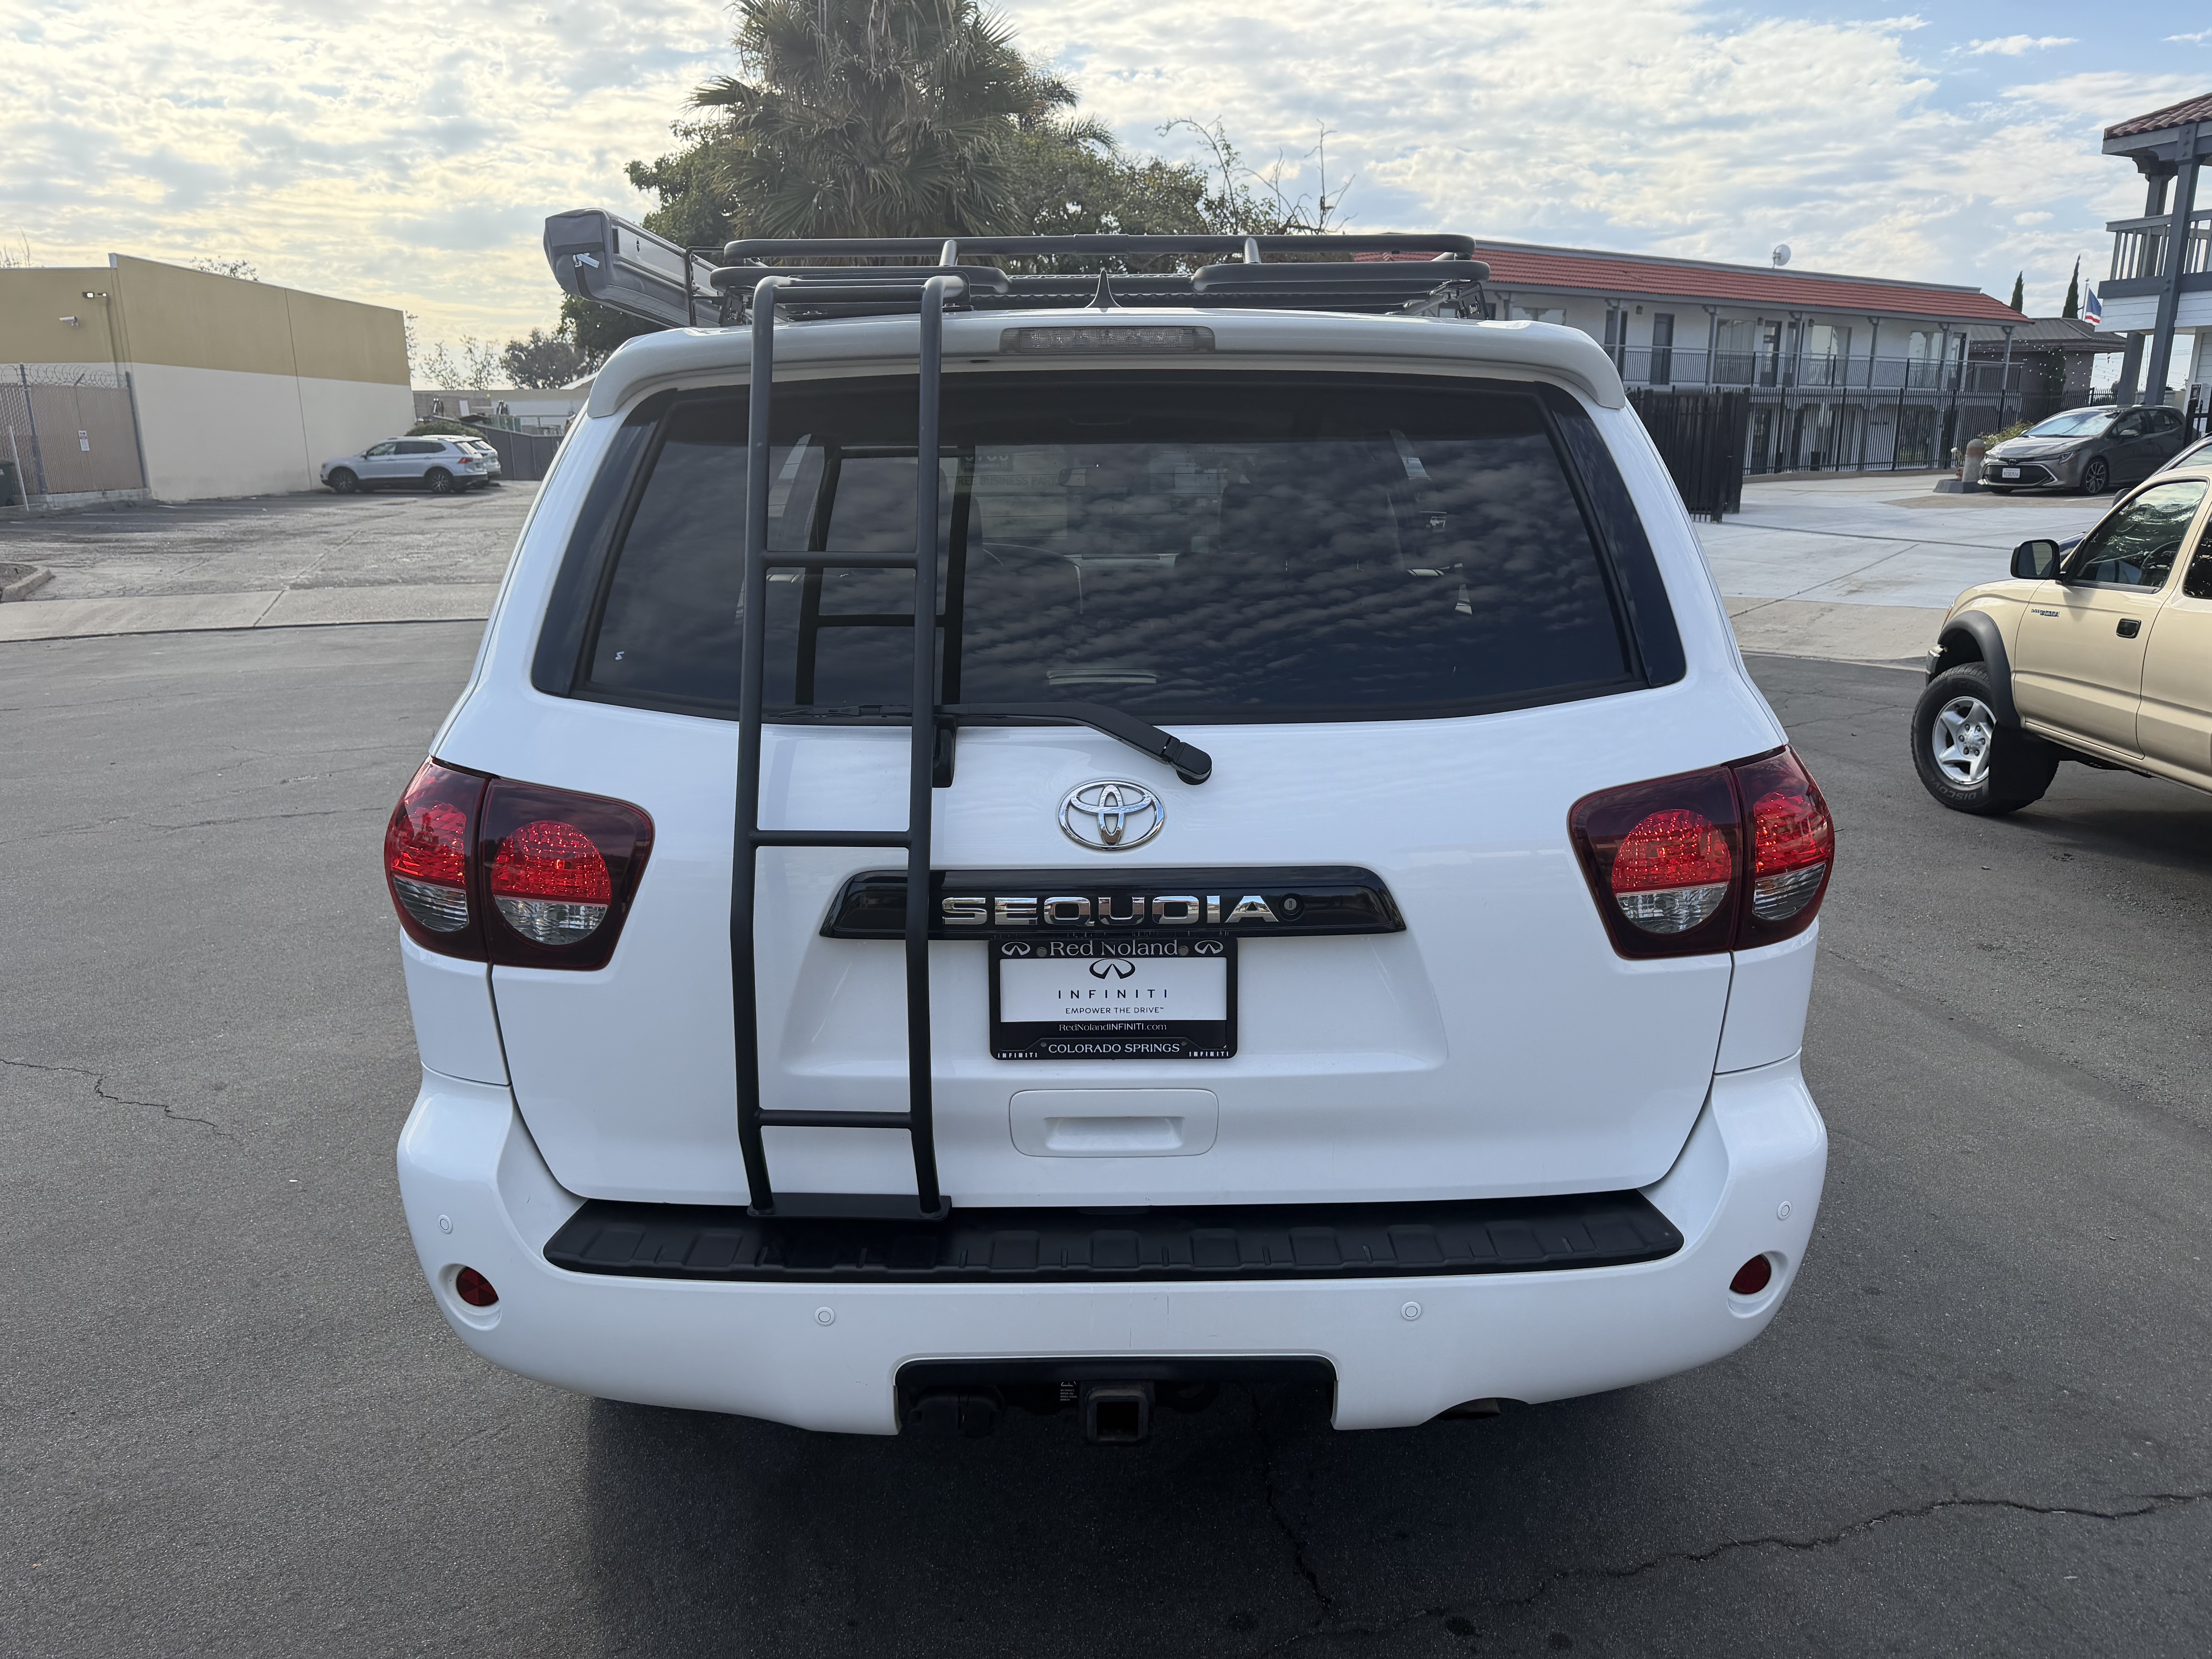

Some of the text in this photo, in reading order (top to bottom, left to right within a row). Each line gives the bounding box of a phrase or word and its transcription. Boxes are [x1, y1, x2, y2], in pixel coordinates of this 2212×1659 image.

[941, 895, 1280, 926] SEQUOIA
[1049, 939, 1178, 956] Red Noland
[1058, 989, 1167, 999] INFINITI
[1059, 1022, 1167, 1031] RedNolandINFINITI.com
[1048, 1043, 1180, 1053] COLORADO SPRINGS
